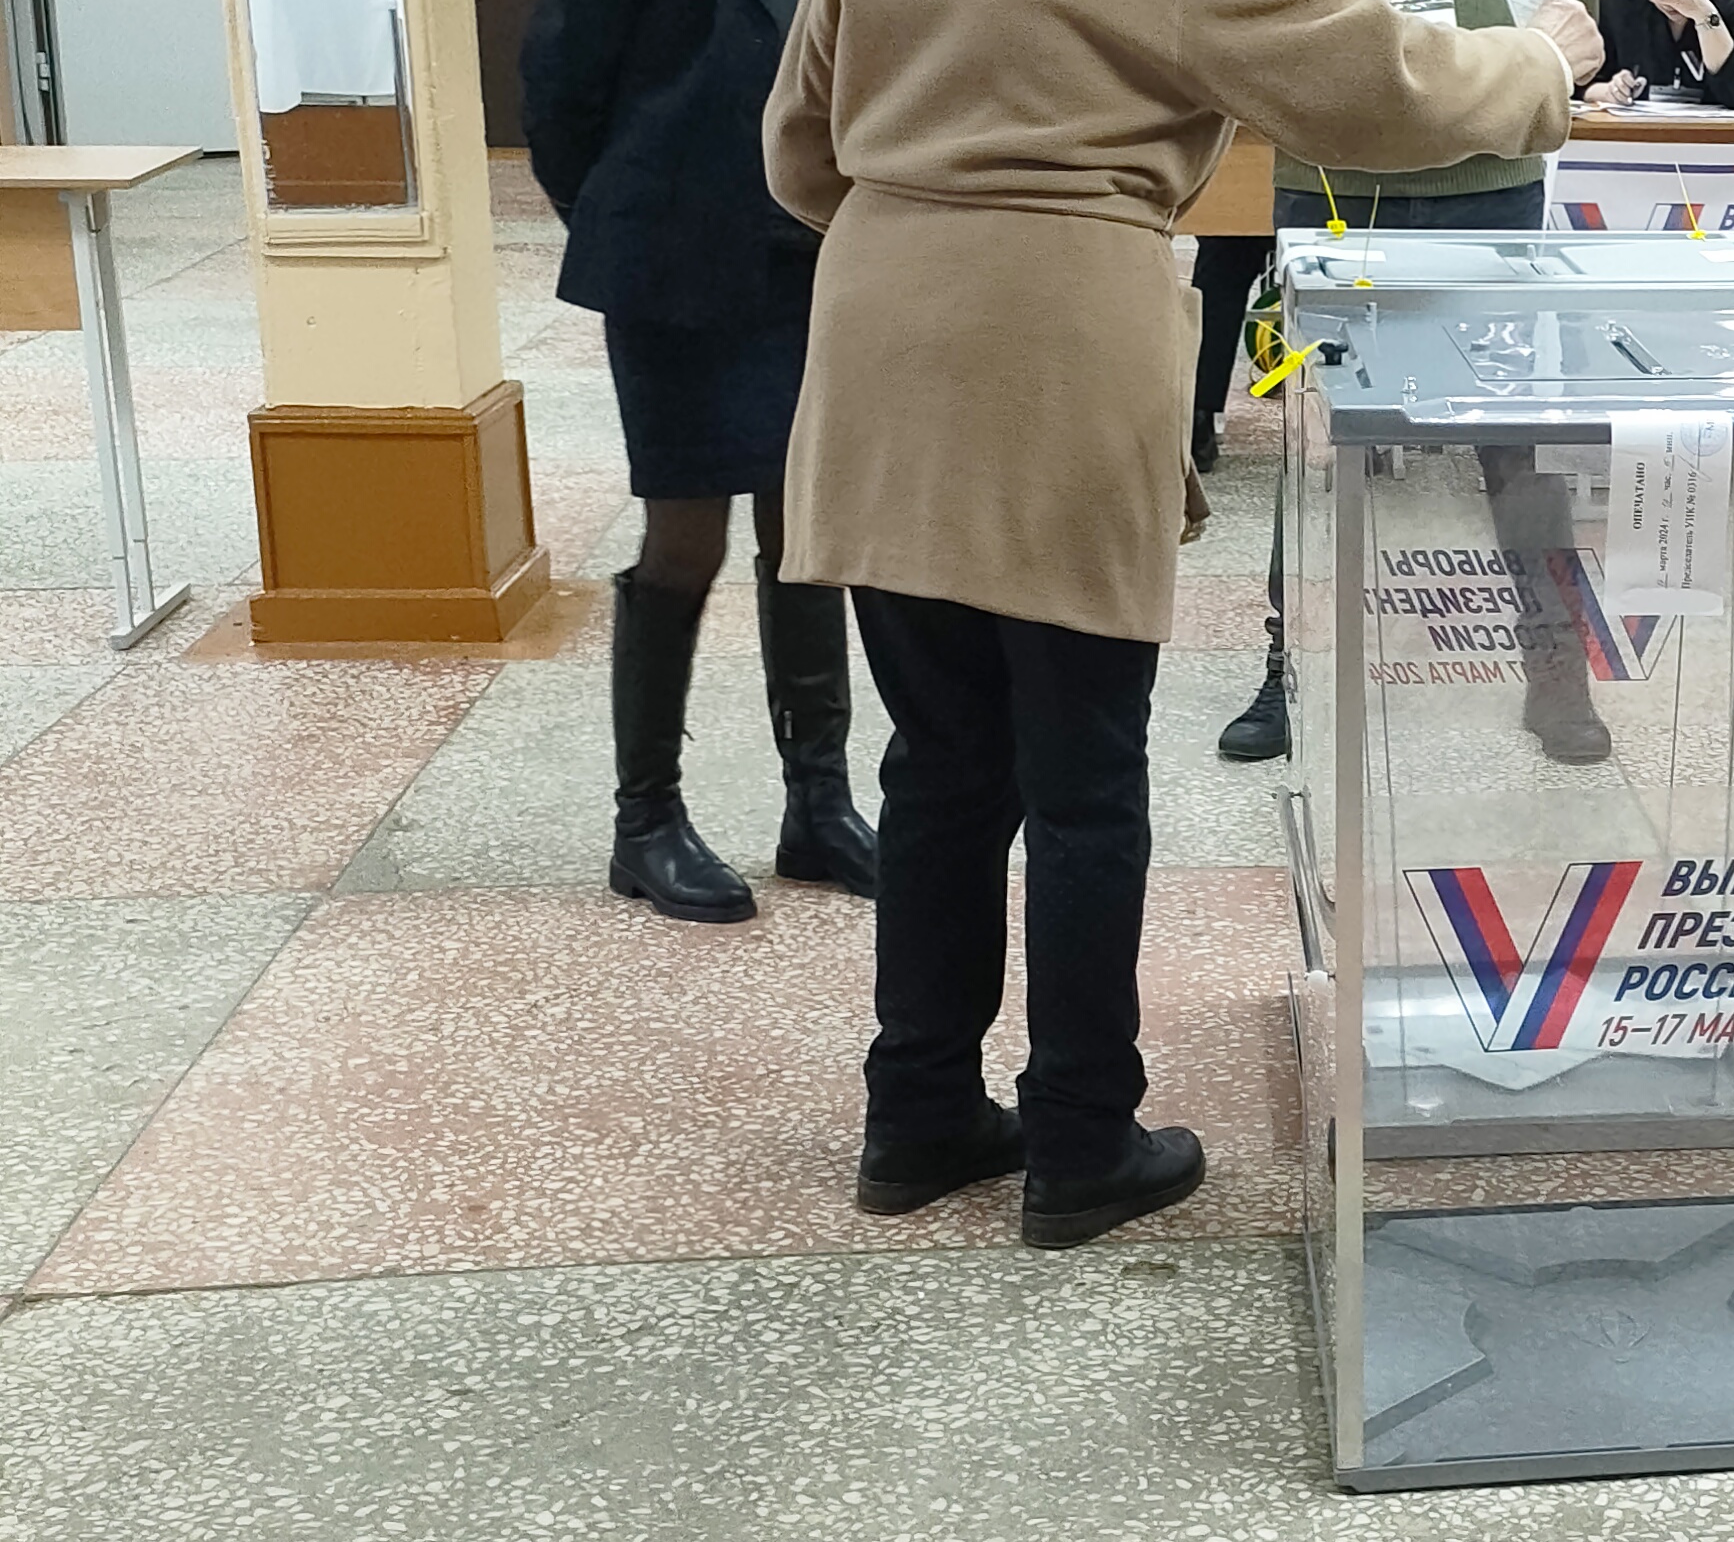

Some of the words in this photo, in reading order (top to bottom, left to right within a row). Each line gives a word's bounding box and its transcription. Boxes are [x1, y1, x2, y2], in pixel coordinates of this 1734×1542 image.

[1632, 461, 1646, 530] ОПЕЧАТАНО
[1658, 524, 1669, 544] 2024
[1685, 506, 1695, 529] УИК
[1681, 530, 1694, 589] Председатель
